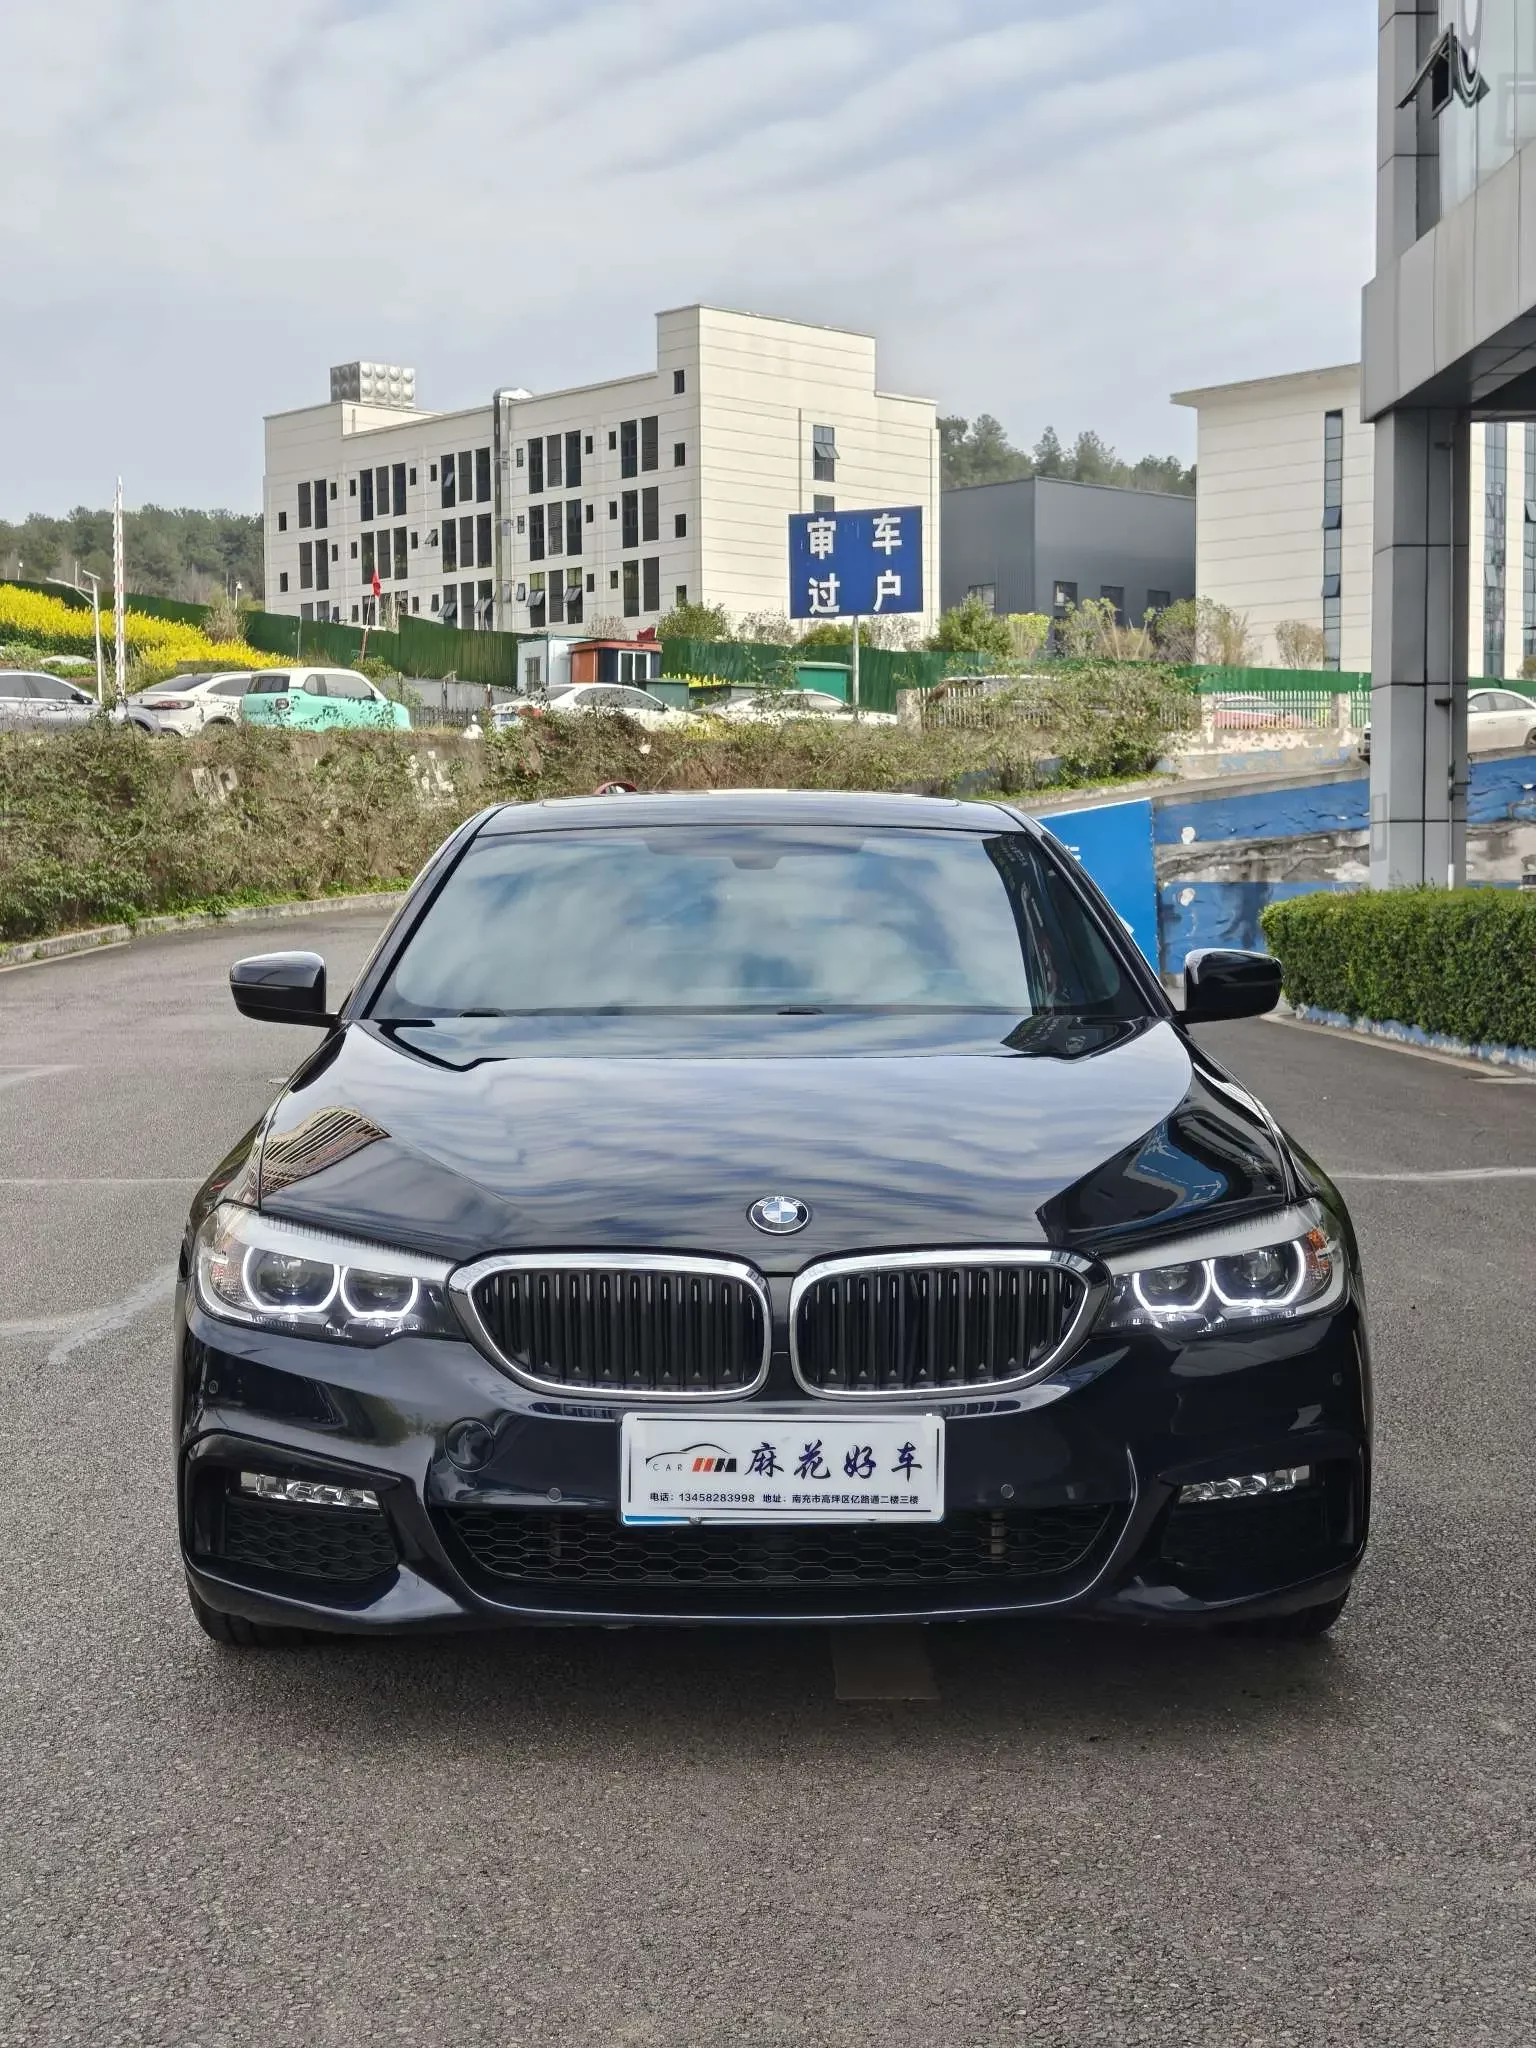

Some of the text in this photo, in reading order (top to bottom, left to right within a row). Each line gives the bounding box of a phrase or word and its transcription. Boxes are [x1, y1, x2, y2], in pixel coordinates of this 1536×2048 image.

[808, 569, 901, 615] 过户
[652, 1463, 683, 1472] CAR
[745, 1439, 922, 1482] 麻花好车
